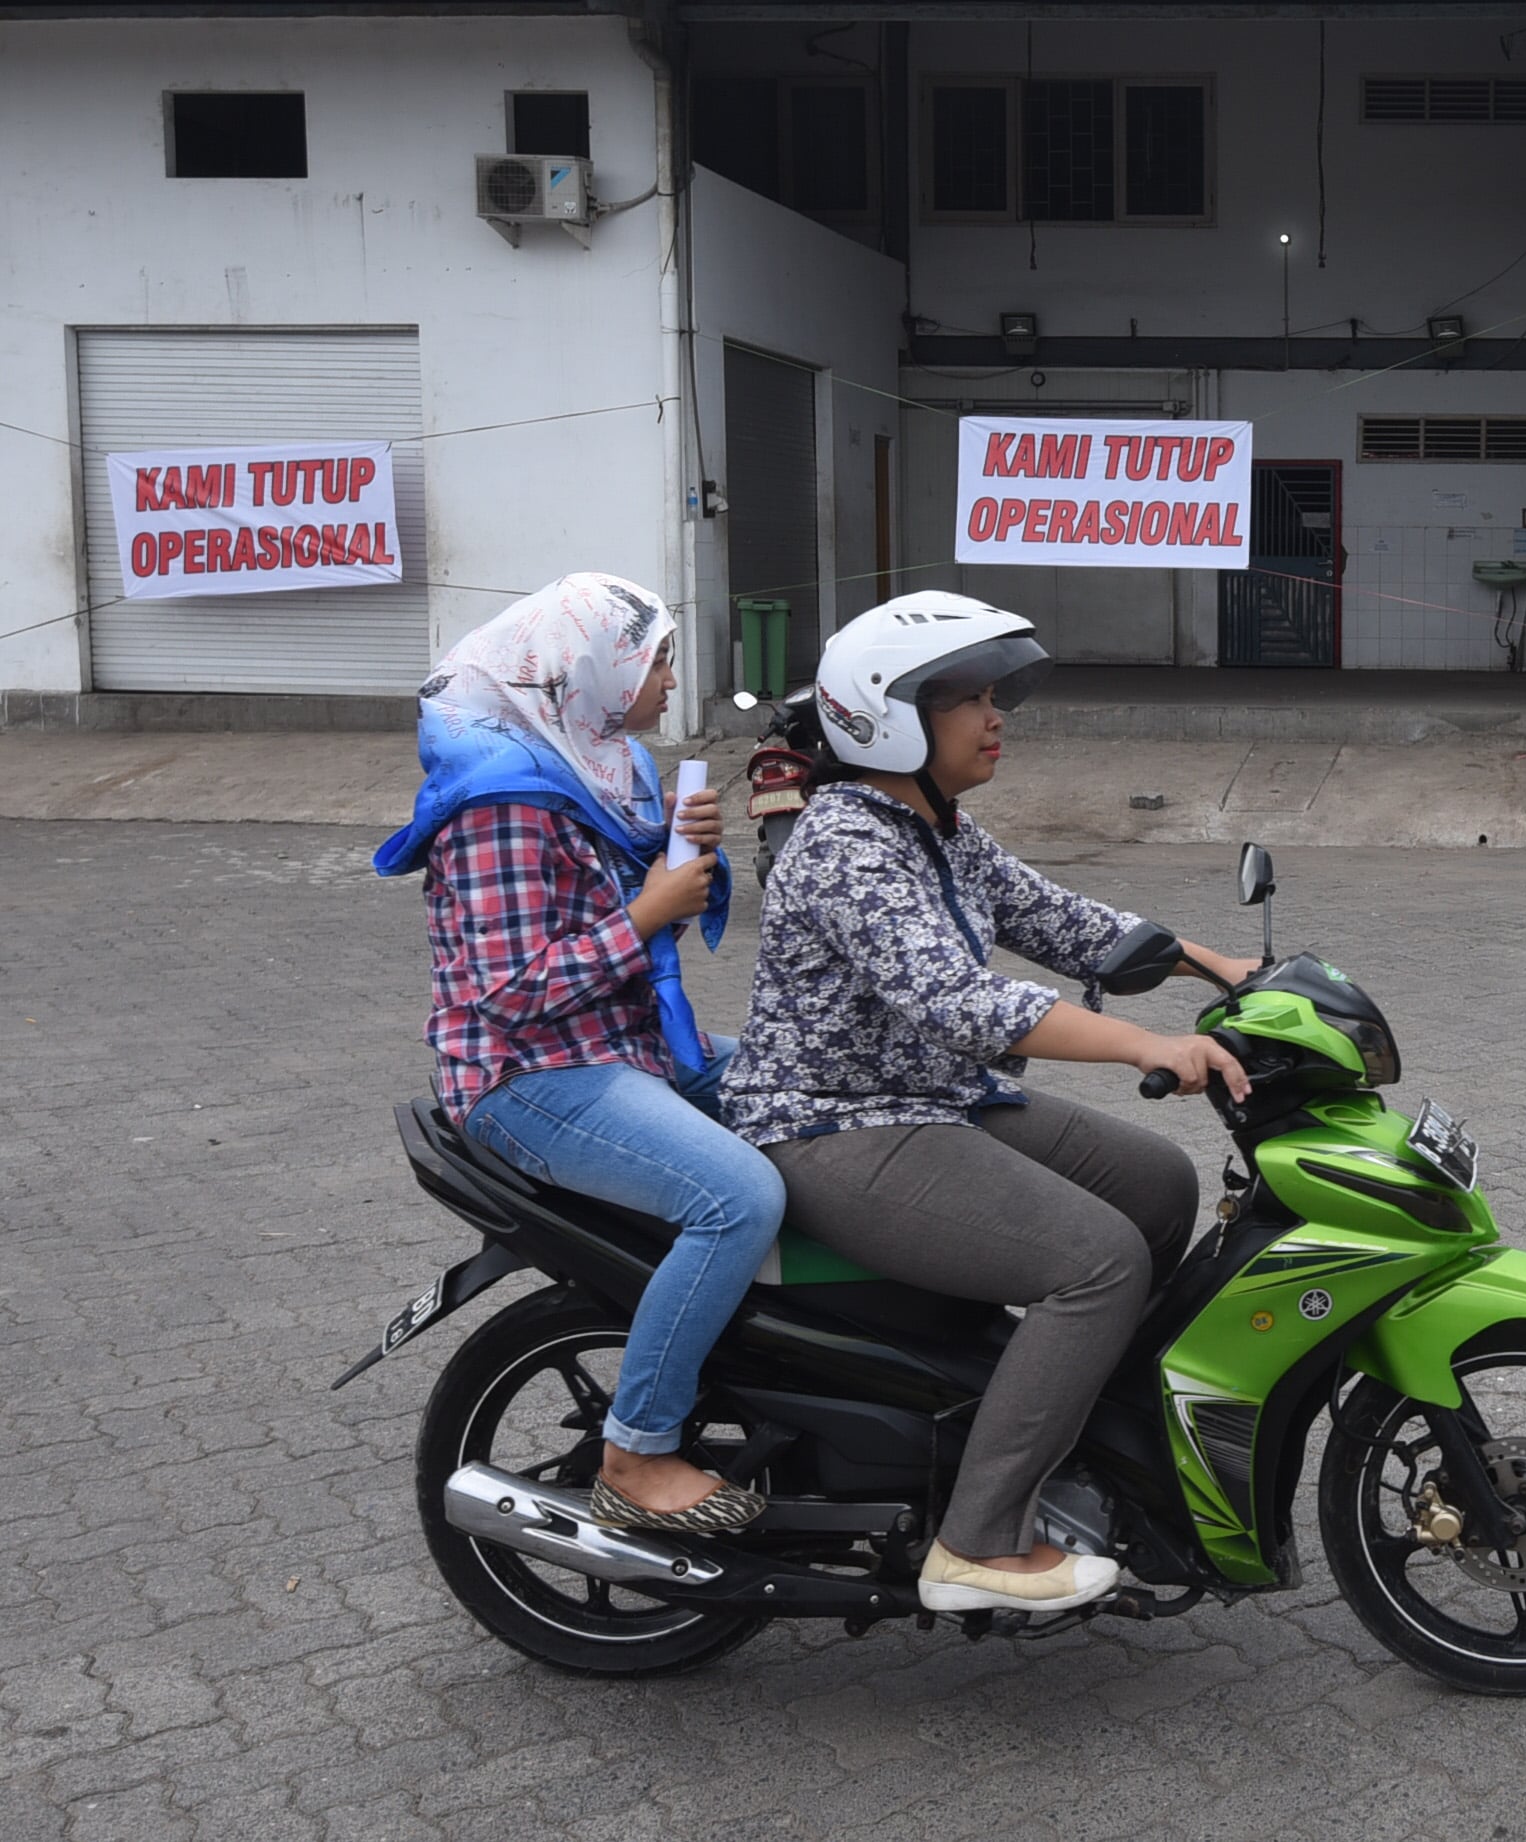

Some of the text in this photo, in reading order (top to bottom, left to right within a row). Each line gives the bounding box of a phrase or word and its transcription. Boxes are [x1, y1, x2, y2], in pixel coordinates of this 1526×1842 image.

[984, 433, 1235, 481] KAMI TUTUP
[135, 457, 376, 512] KAMI TUTUP
[968, 497, 1243, 546] OPERASIONAL
[131, 522, 395, 577] OPERASIONAL
